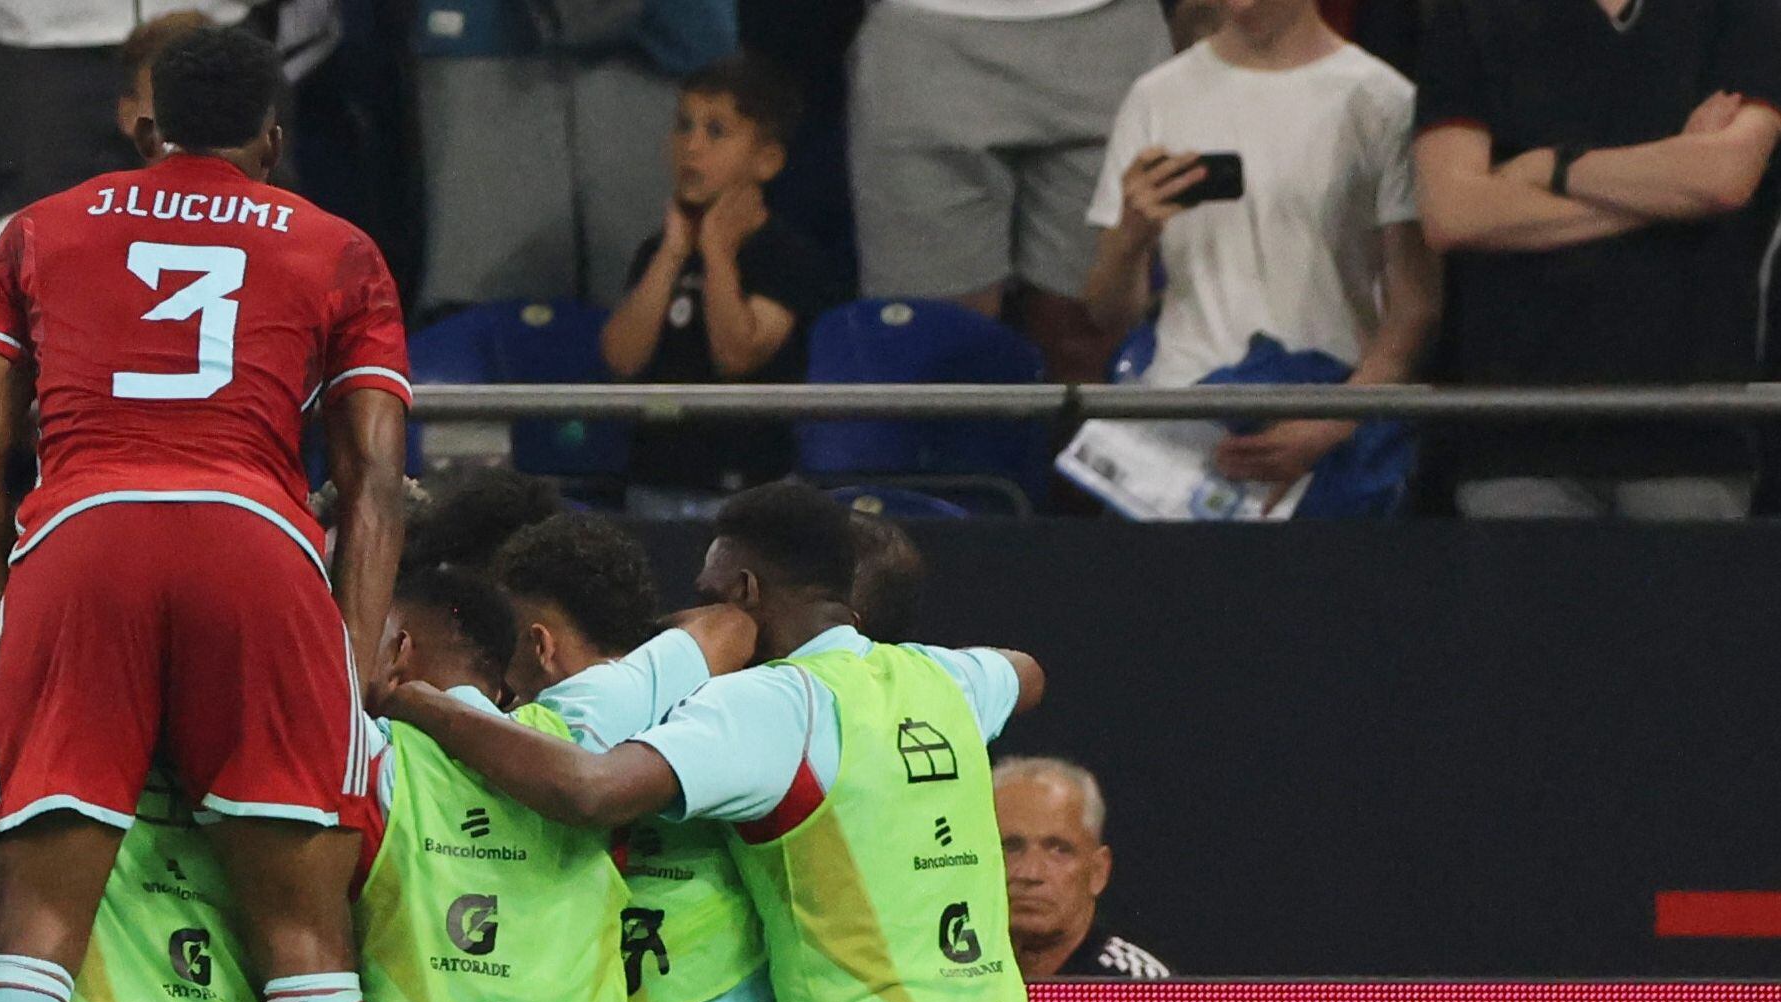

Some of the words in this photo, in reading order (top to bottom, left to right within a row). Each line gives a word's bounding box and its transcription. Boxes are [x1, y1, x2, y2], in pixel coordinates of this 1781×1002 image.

[87, 185, 294, 232] J.LUCUMI
[112, 241, 248, 400] 3
[424, 838, 528, 861] Bancolombia
[913, 853, 979, 871] Bancolombia
[430, 957, 511, 978] GATORADE
